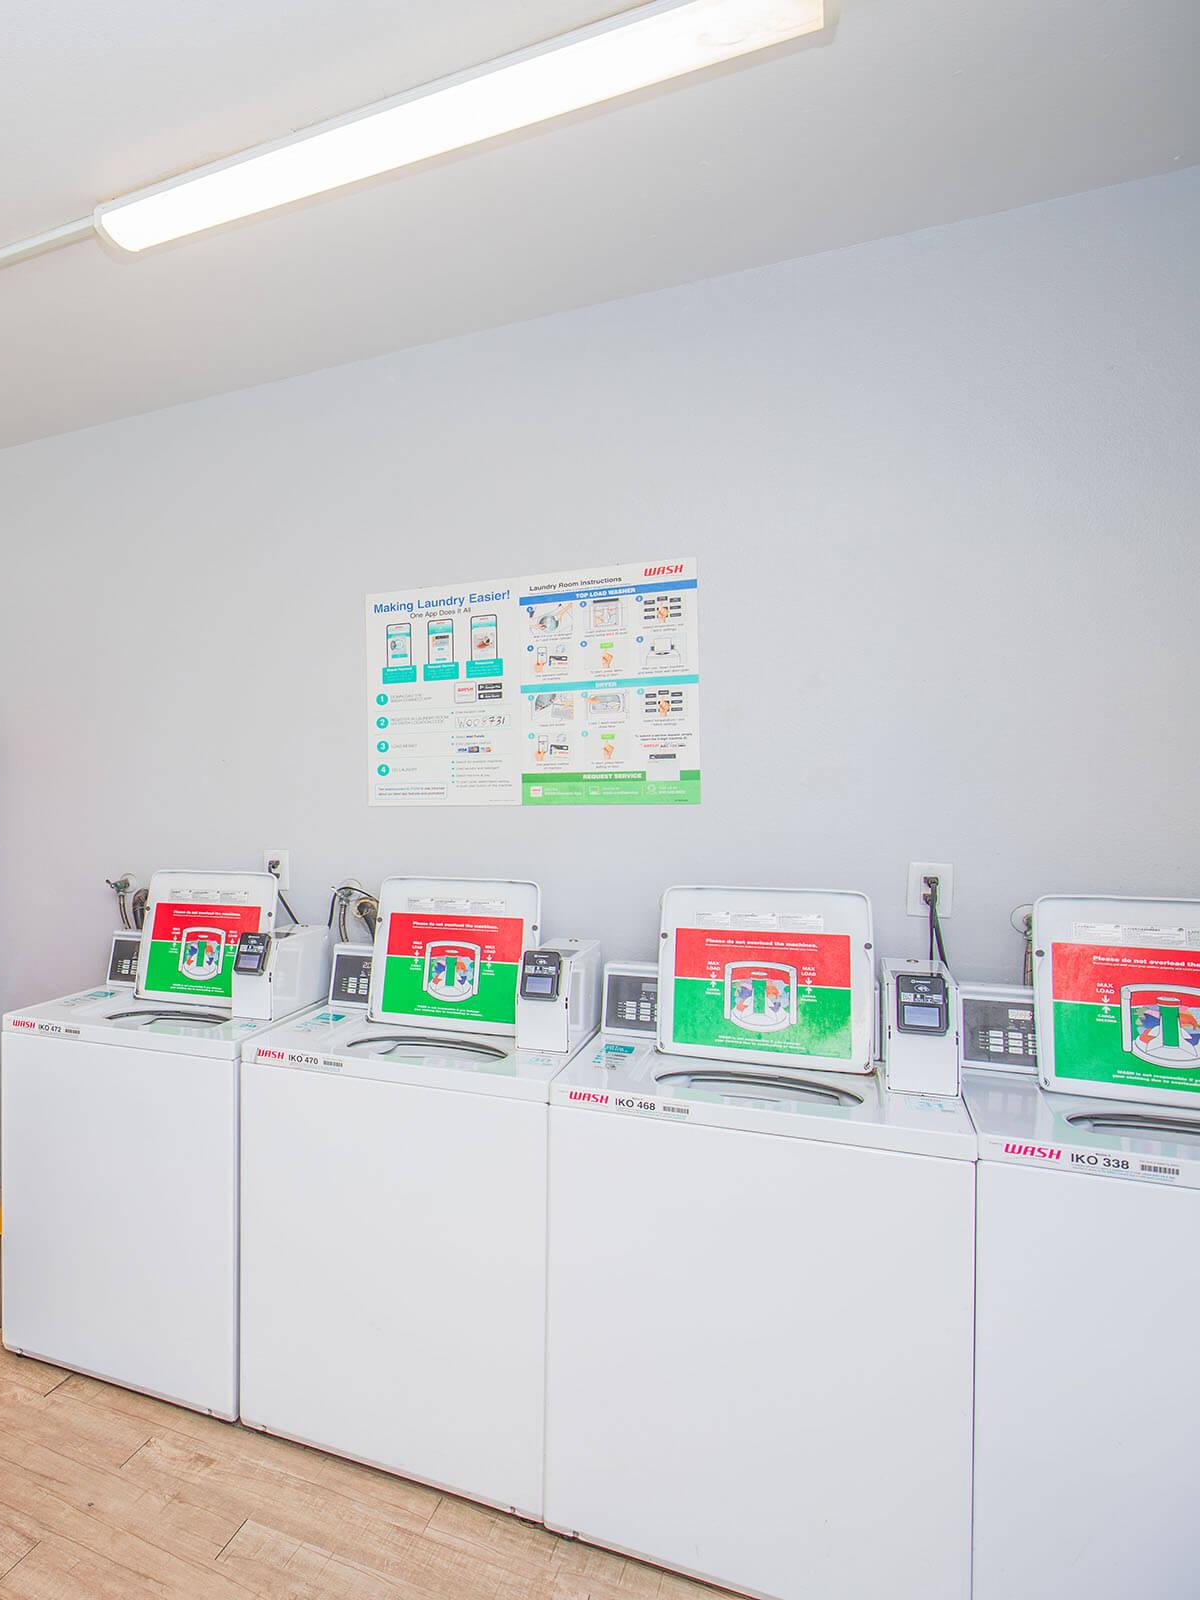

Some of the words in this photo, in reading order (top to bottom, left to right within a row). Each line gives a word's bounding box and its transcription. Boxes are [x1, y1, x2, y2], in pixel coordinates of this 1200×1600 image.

[644, 564, 684, 577] WASH
[529, 584, 557, 592] Laundry
[580, 576, 622, 586] Instructions
[374, 601, 414, 614] Making
[417, 596, 465, 609] Laundry
[469, 590, 511, 604] Easier!
[425, 610, 438, 618] App
[439, 608, 456, 616] Does
[12, 1019, 36, 1029] WASH
[38, 1024, 50, 1032] IKO
[257, 1048, 285, 1060] WASH
[288, 1054, 302, 1063] IKO
[304, 1056, 318, 1064] 470
[569, 1090, 609, 1104] WASH
[616, 1098, 634, 1108] IKO
[637, 1100, 656, 1111] 468
[1004, 1143, 1062, 1160] WASH
[1071, 1152, 1098, 1166] IKO
[1103, 1157, 1130, 1170] 338
